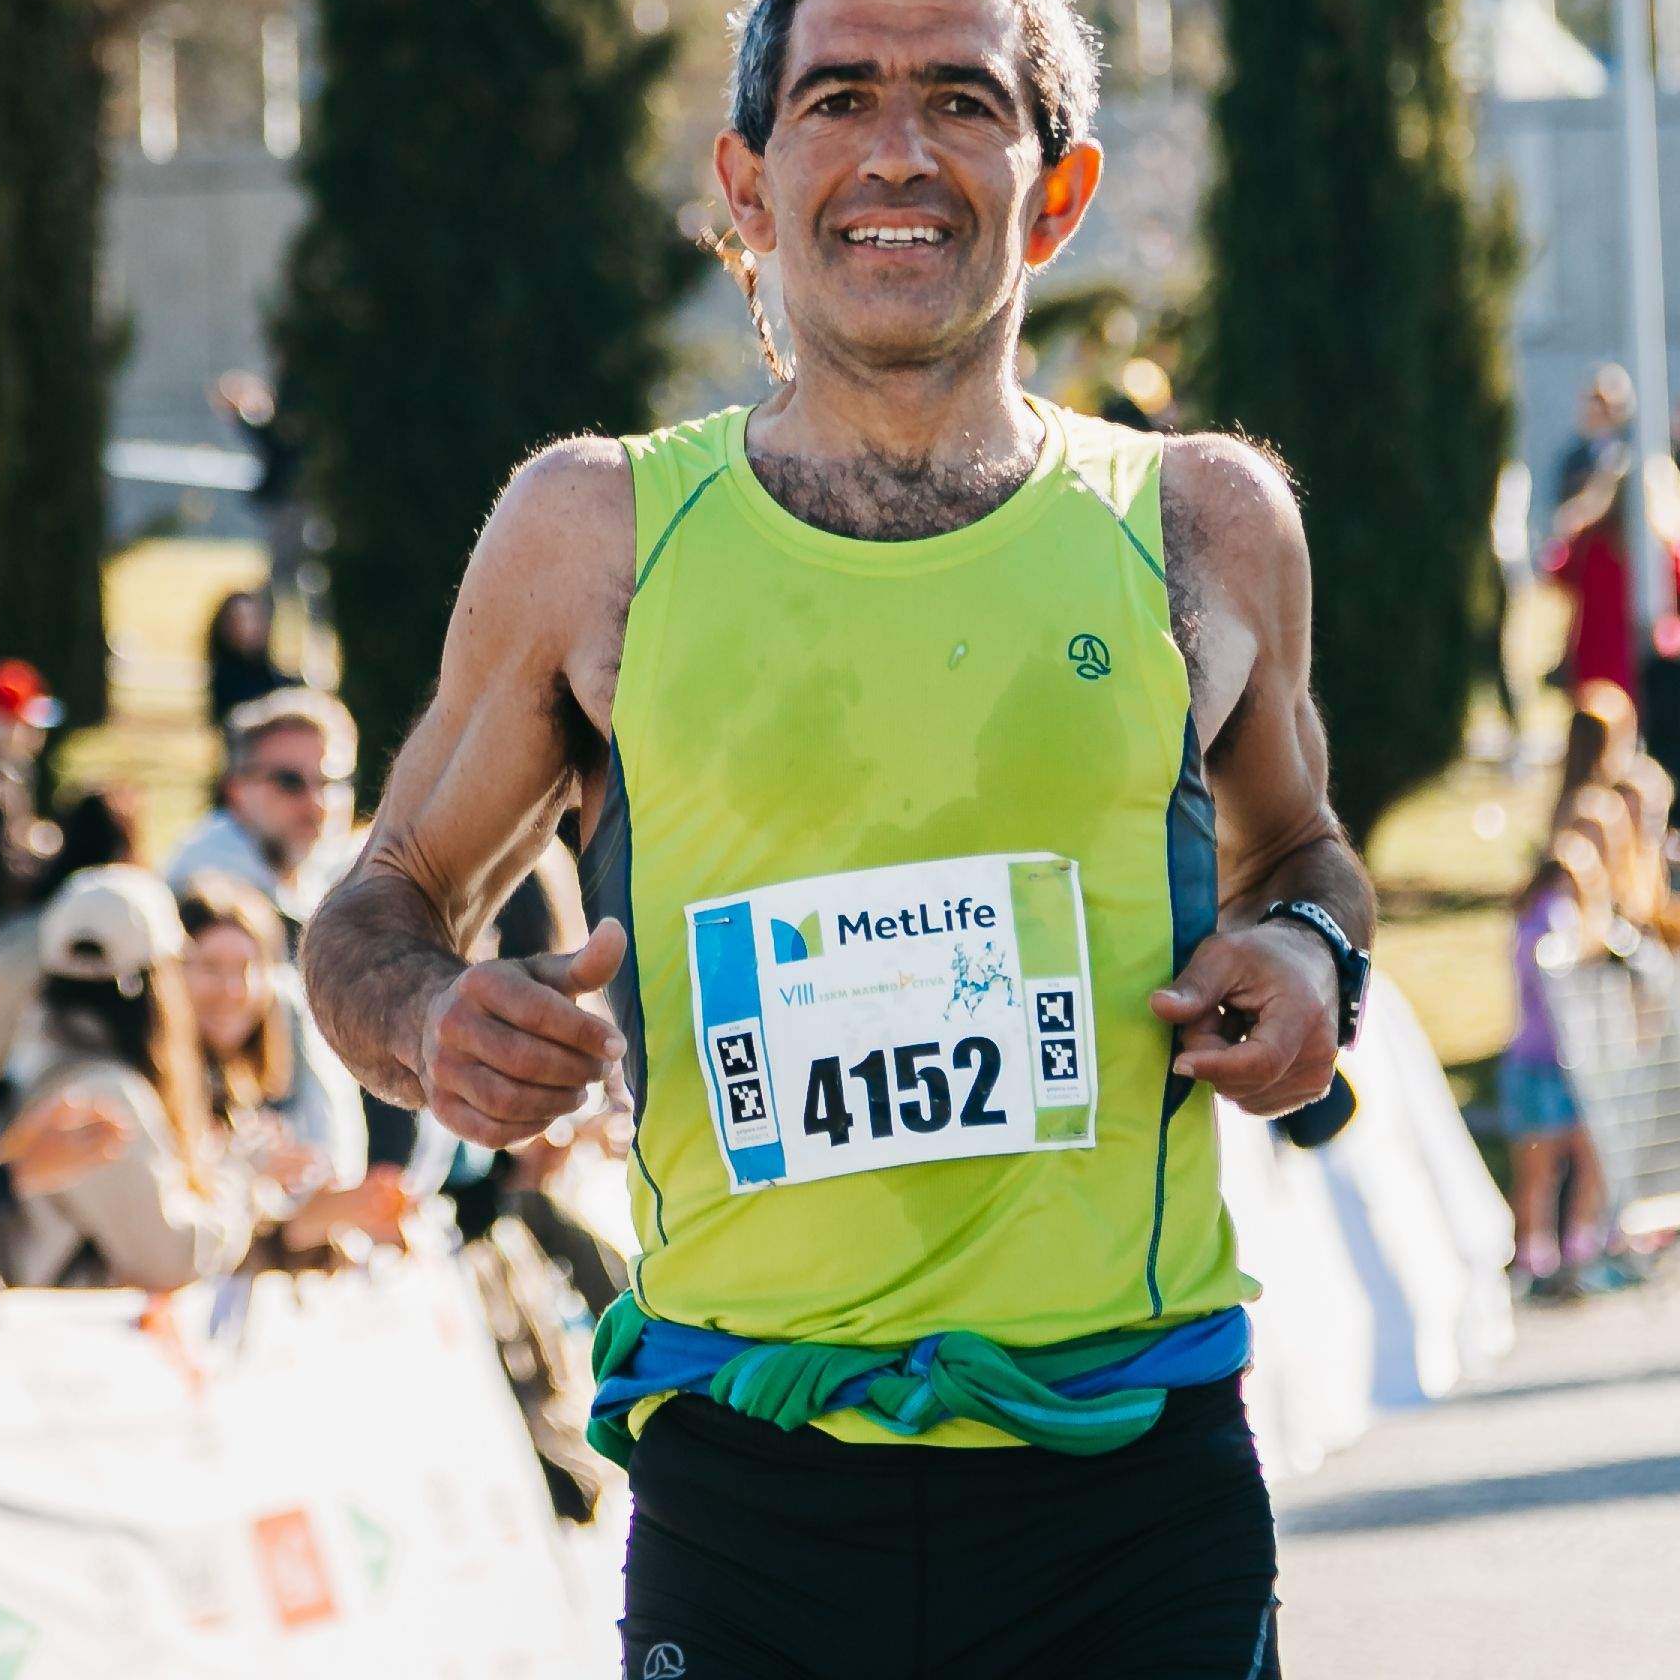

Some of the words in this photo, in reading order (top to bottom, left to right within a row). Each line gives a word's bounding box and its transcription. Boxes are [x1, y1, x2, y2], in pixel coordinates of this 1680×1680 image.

[837, 897, 997, 946] MetLife
[778, 982, 815, 1007] VIII
[803, 1036, 1008, 1147] 4152
